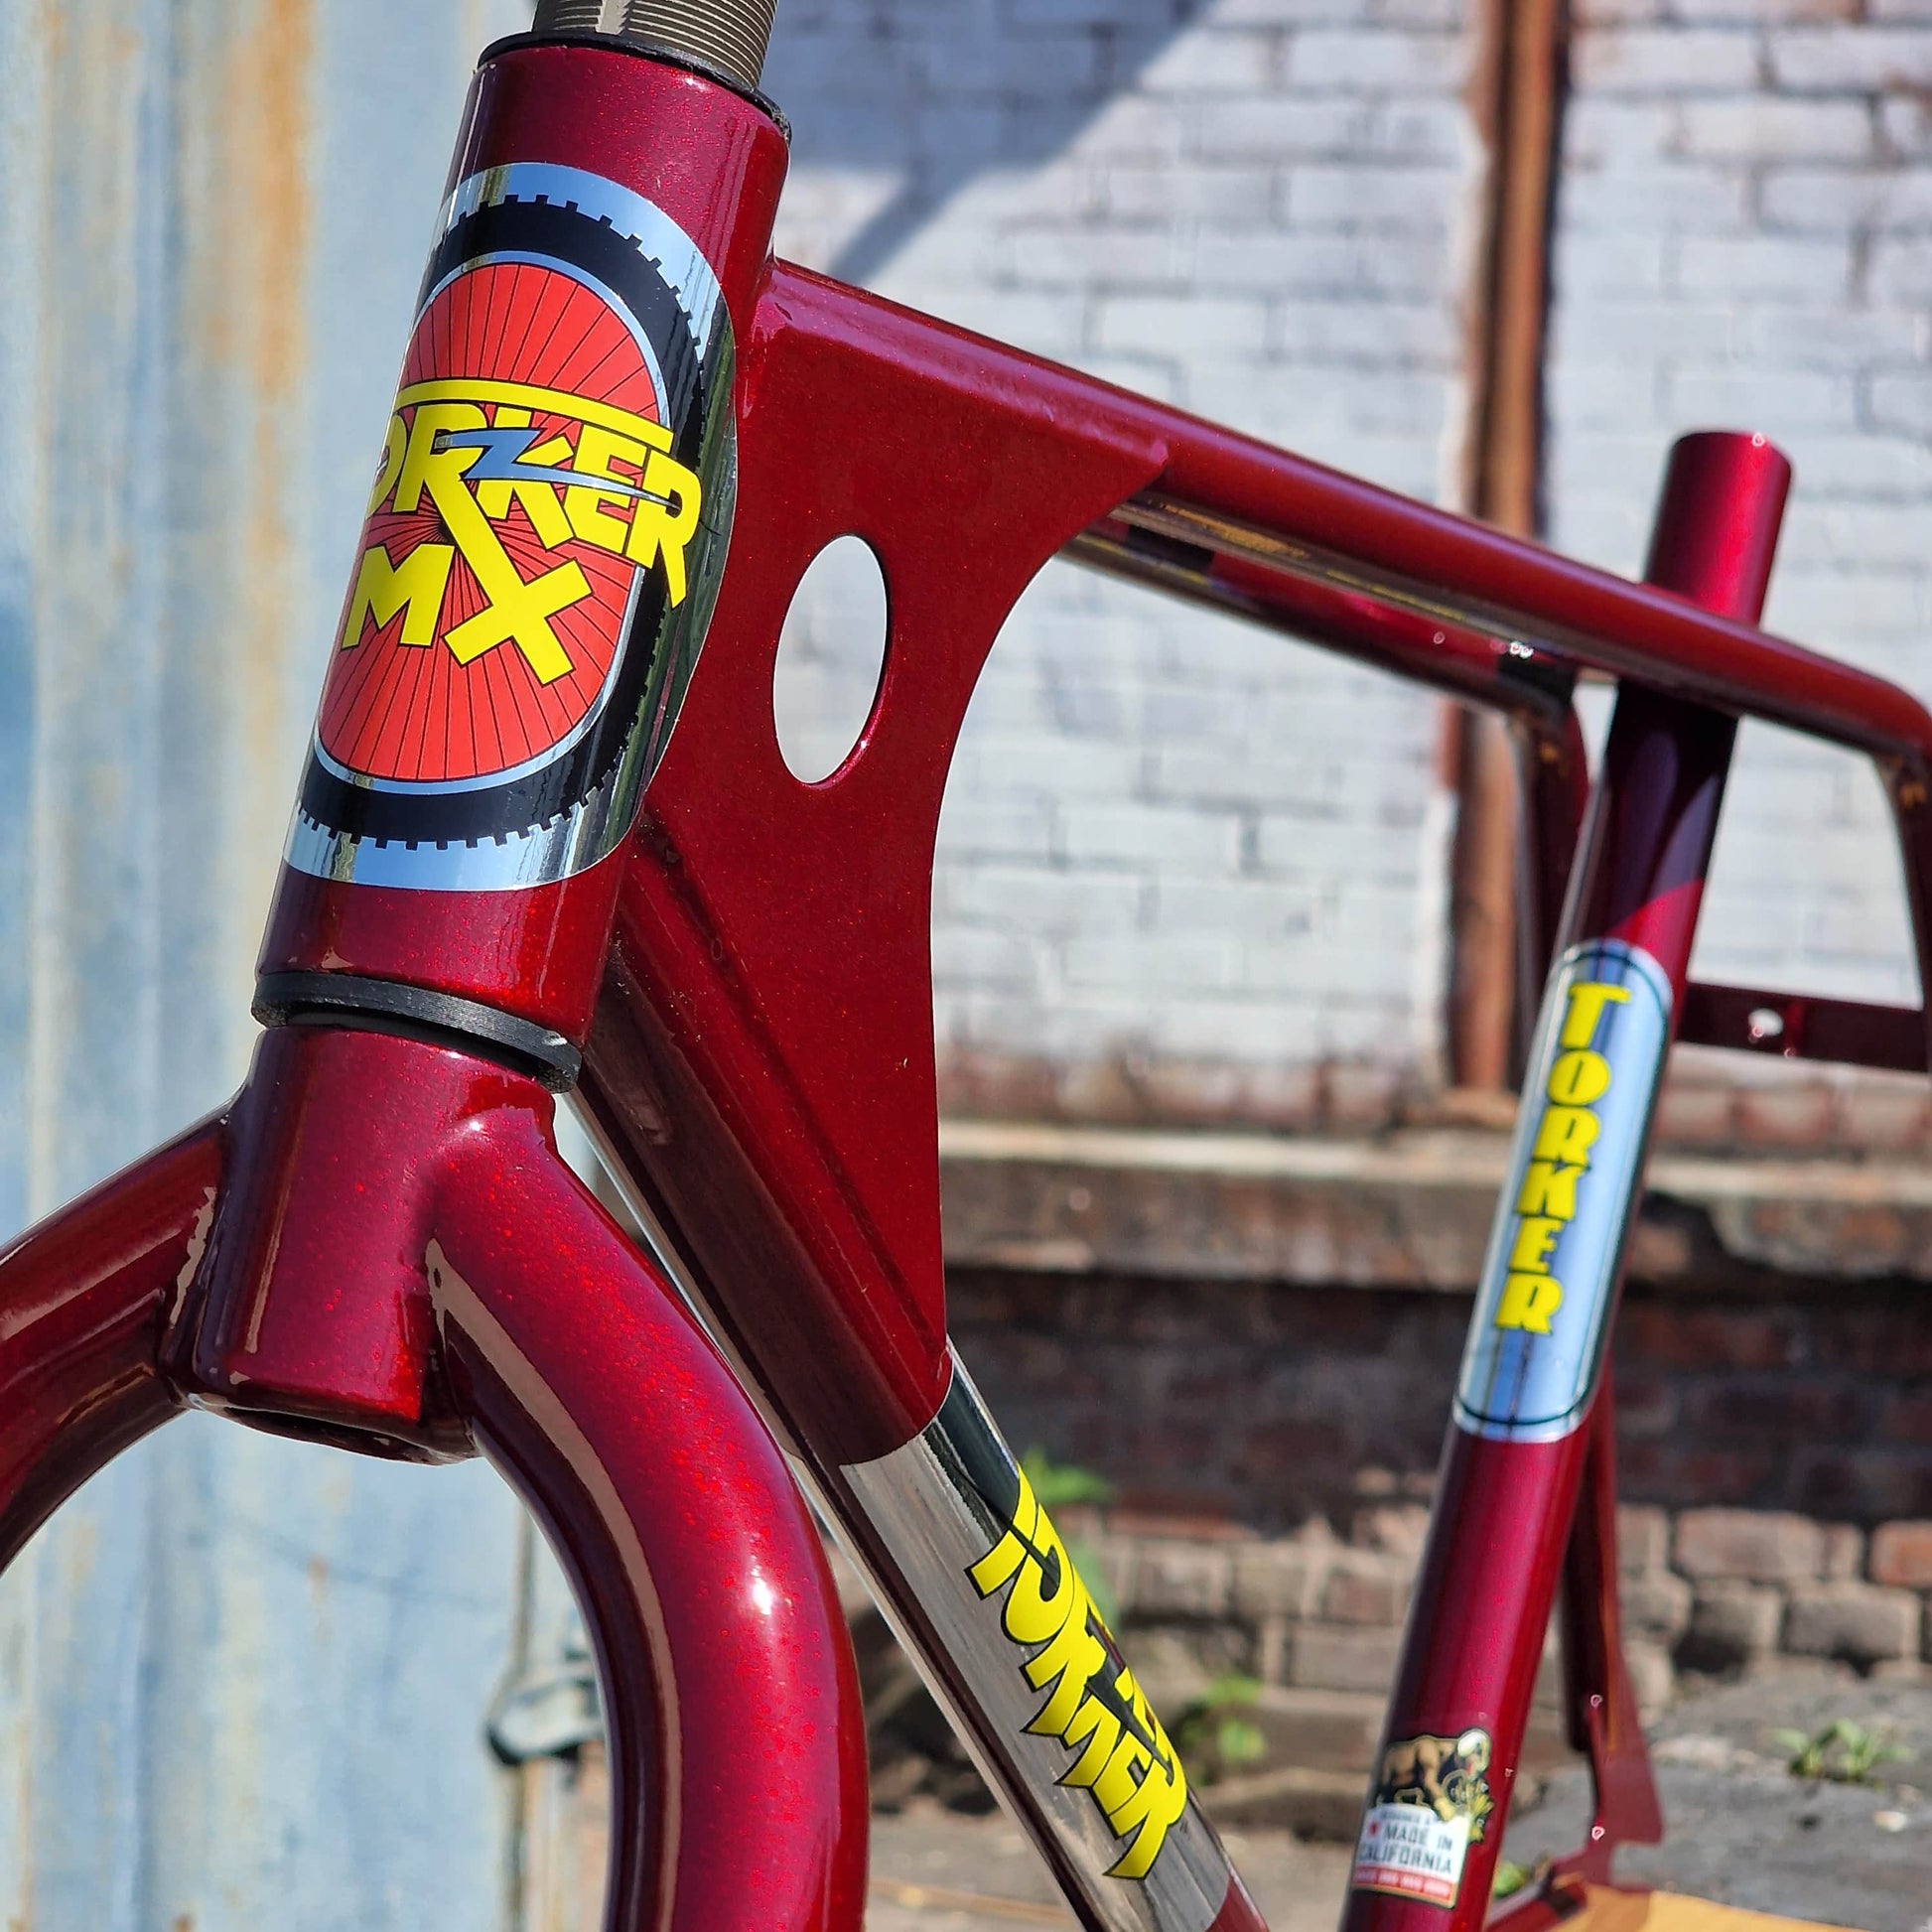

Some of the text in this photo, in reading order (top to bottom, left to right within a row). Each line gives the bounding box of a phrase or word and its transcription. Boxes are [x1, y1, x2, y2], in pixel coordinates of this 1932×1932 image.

[341, 543, 594, 686] MX
[1495, 982, 1631, 1334] TORKER
[964, 1459, 1187, 1880] TORKER
[1359, 1843, 1452, 1873] CALIFORNIA
[1385, 1823, 1452, 1853] MADE IN
